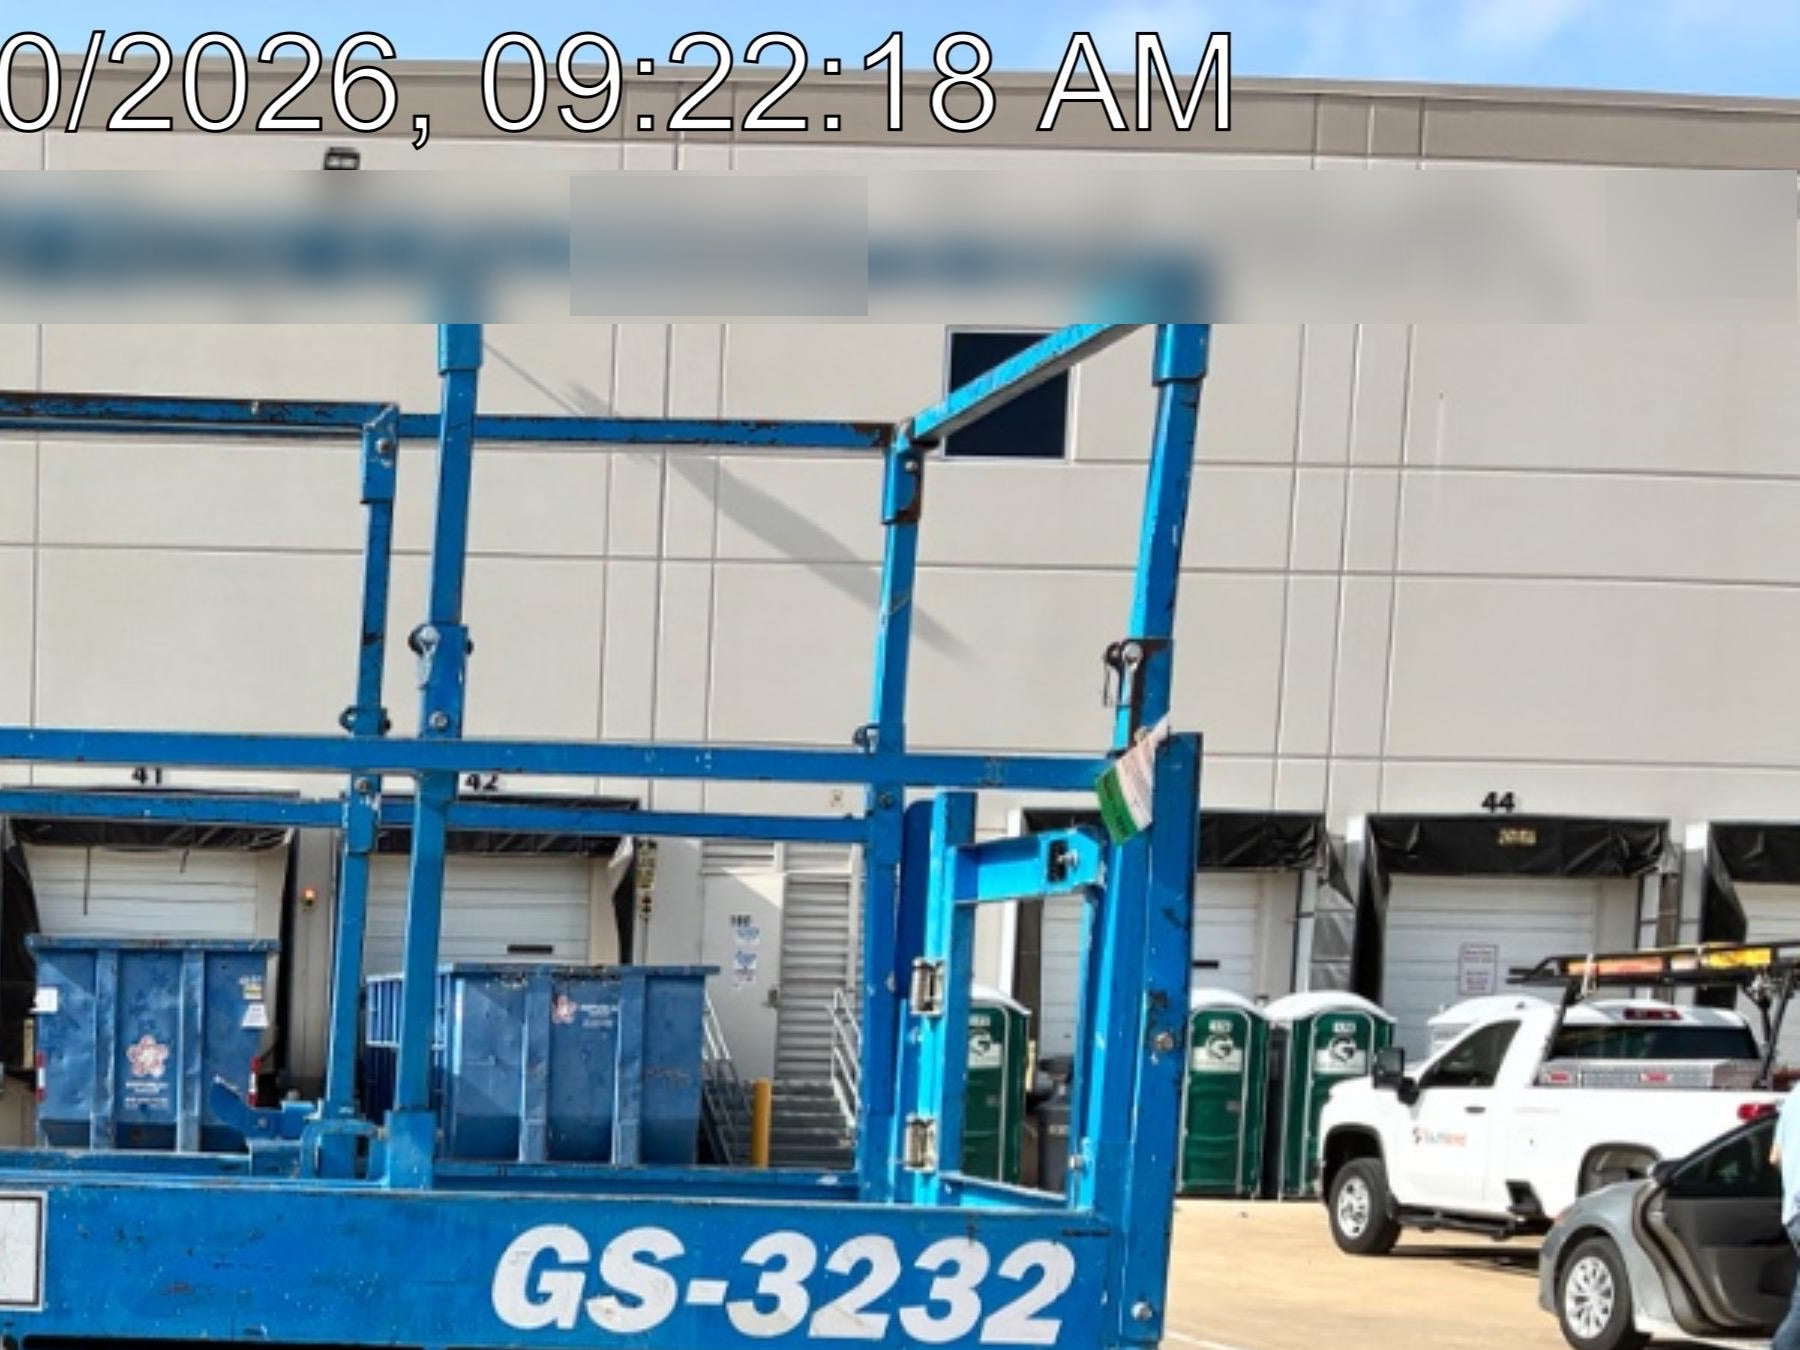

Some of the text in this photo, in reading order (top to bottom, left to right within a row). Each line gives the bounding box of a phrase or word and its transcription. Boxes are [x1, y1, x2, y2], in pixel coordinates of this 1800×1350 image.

[131, 766, 163, 786] 41
[465, 772, 499, 793] 42
[1481, 791, 1516, 814] 44
[491, 1224, 1076, 1346] GS-3232
